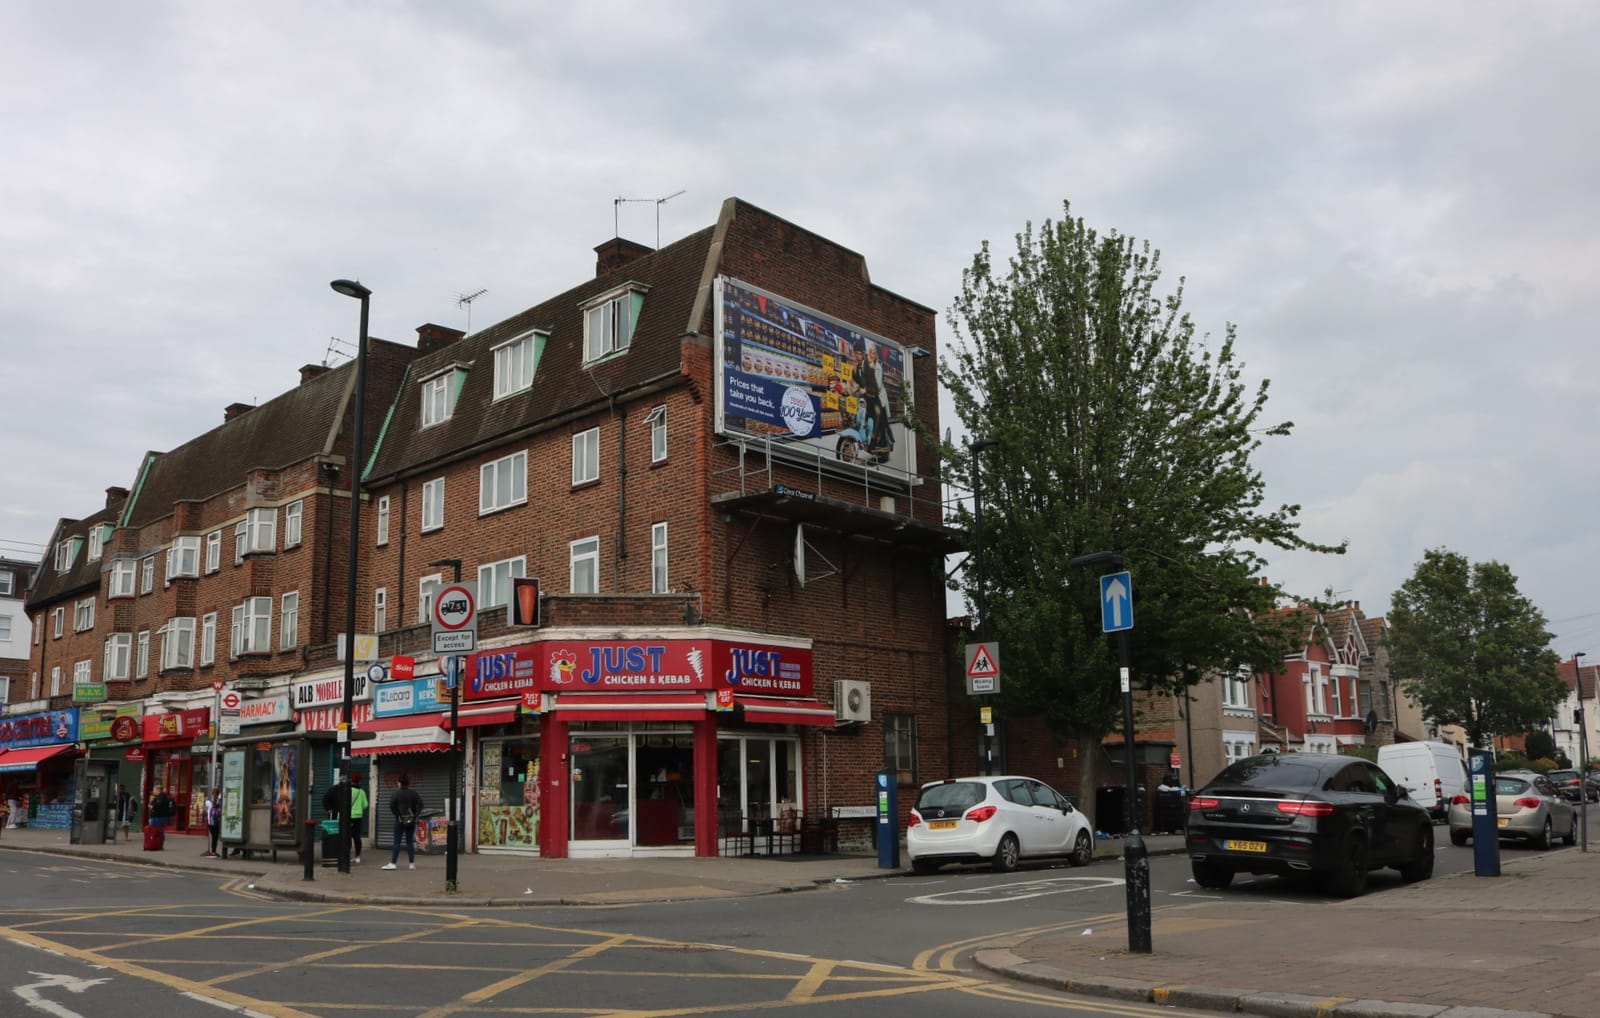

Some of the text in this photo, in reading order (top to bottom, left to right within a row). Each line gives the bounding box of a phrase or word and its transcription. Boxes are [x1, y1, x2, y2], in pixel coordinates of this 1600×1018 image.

[729, 376, 764, 395] Prices that
[729, 389, 775, 409] take you back.
[780, 404, 795, 418] 100
[437, 633, 459, 642] Except
[471, 651, 517, 693] JUST
[581, 645, 666, 684] JUST
[725, 647, 783, 685] JUST
[214, 680, 222, 688] W
[484, 681, 508, 692] CHICKEN
[514, 678, 534, 688] KEBAB
[604, 674, 691, 685] CHICKEN & KEBAB
[741, 677, 801, 690] CHICKEN & KEBAB
[298, 685, 314, 704] ALB
[315, 679, 343, 701] MOBILE
[241, 701, 277, 718] HARMACY
